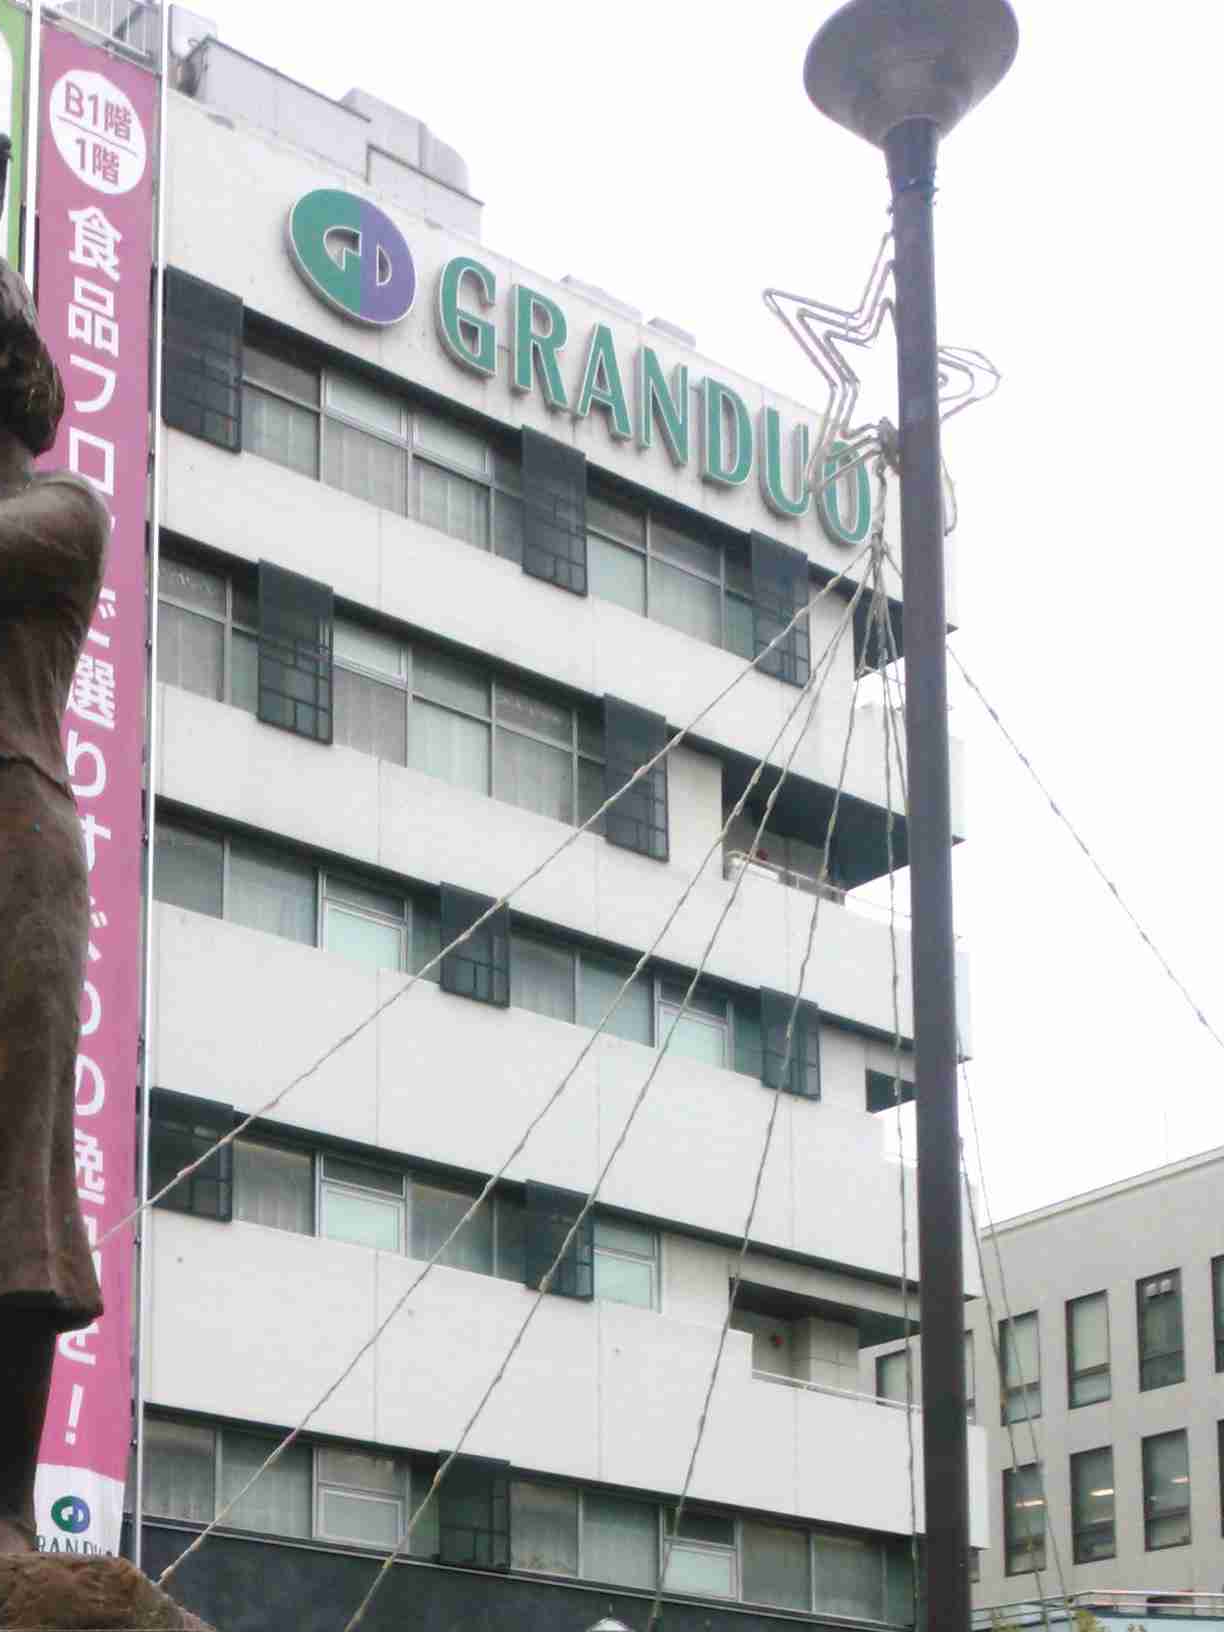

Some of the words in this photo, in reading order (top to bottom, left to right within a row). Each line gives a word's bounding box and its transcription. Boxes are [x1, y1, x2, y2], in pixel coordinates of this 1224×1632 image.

[65, 80, 132, 142] B1階
[75, 137, 120, 187] 1階
[439, 256, 873, 545] GRANDUO
